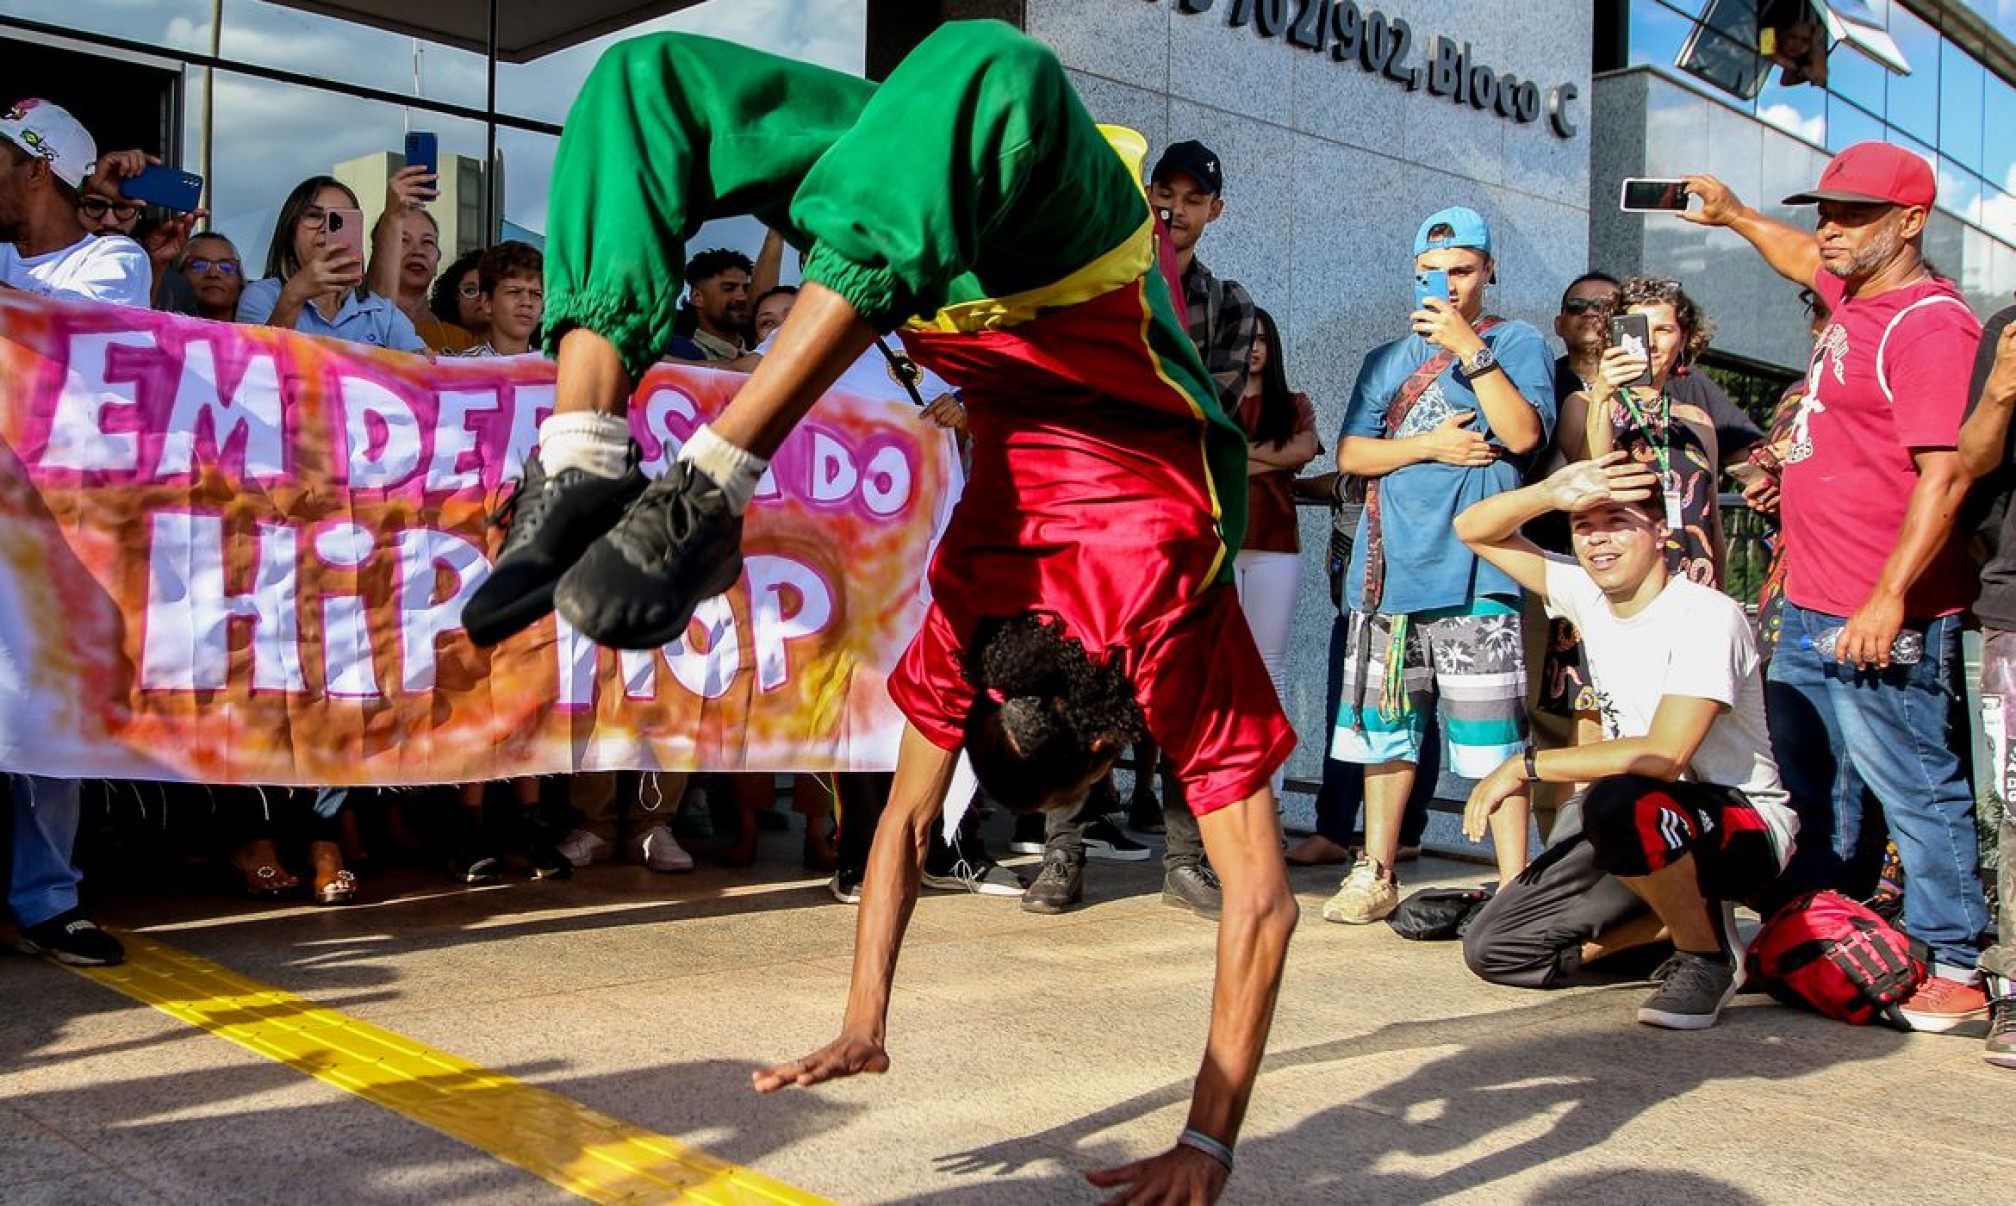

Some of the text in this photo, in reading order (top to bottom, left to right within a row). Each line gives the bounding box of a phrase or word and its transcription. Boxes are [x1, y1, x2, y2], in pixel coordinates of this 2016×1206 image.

[1428, 35, 1541, 123] Bloco
[1549, 81, 1579, 139] C
[39, 330, 911, 515] EM DEFS DO
